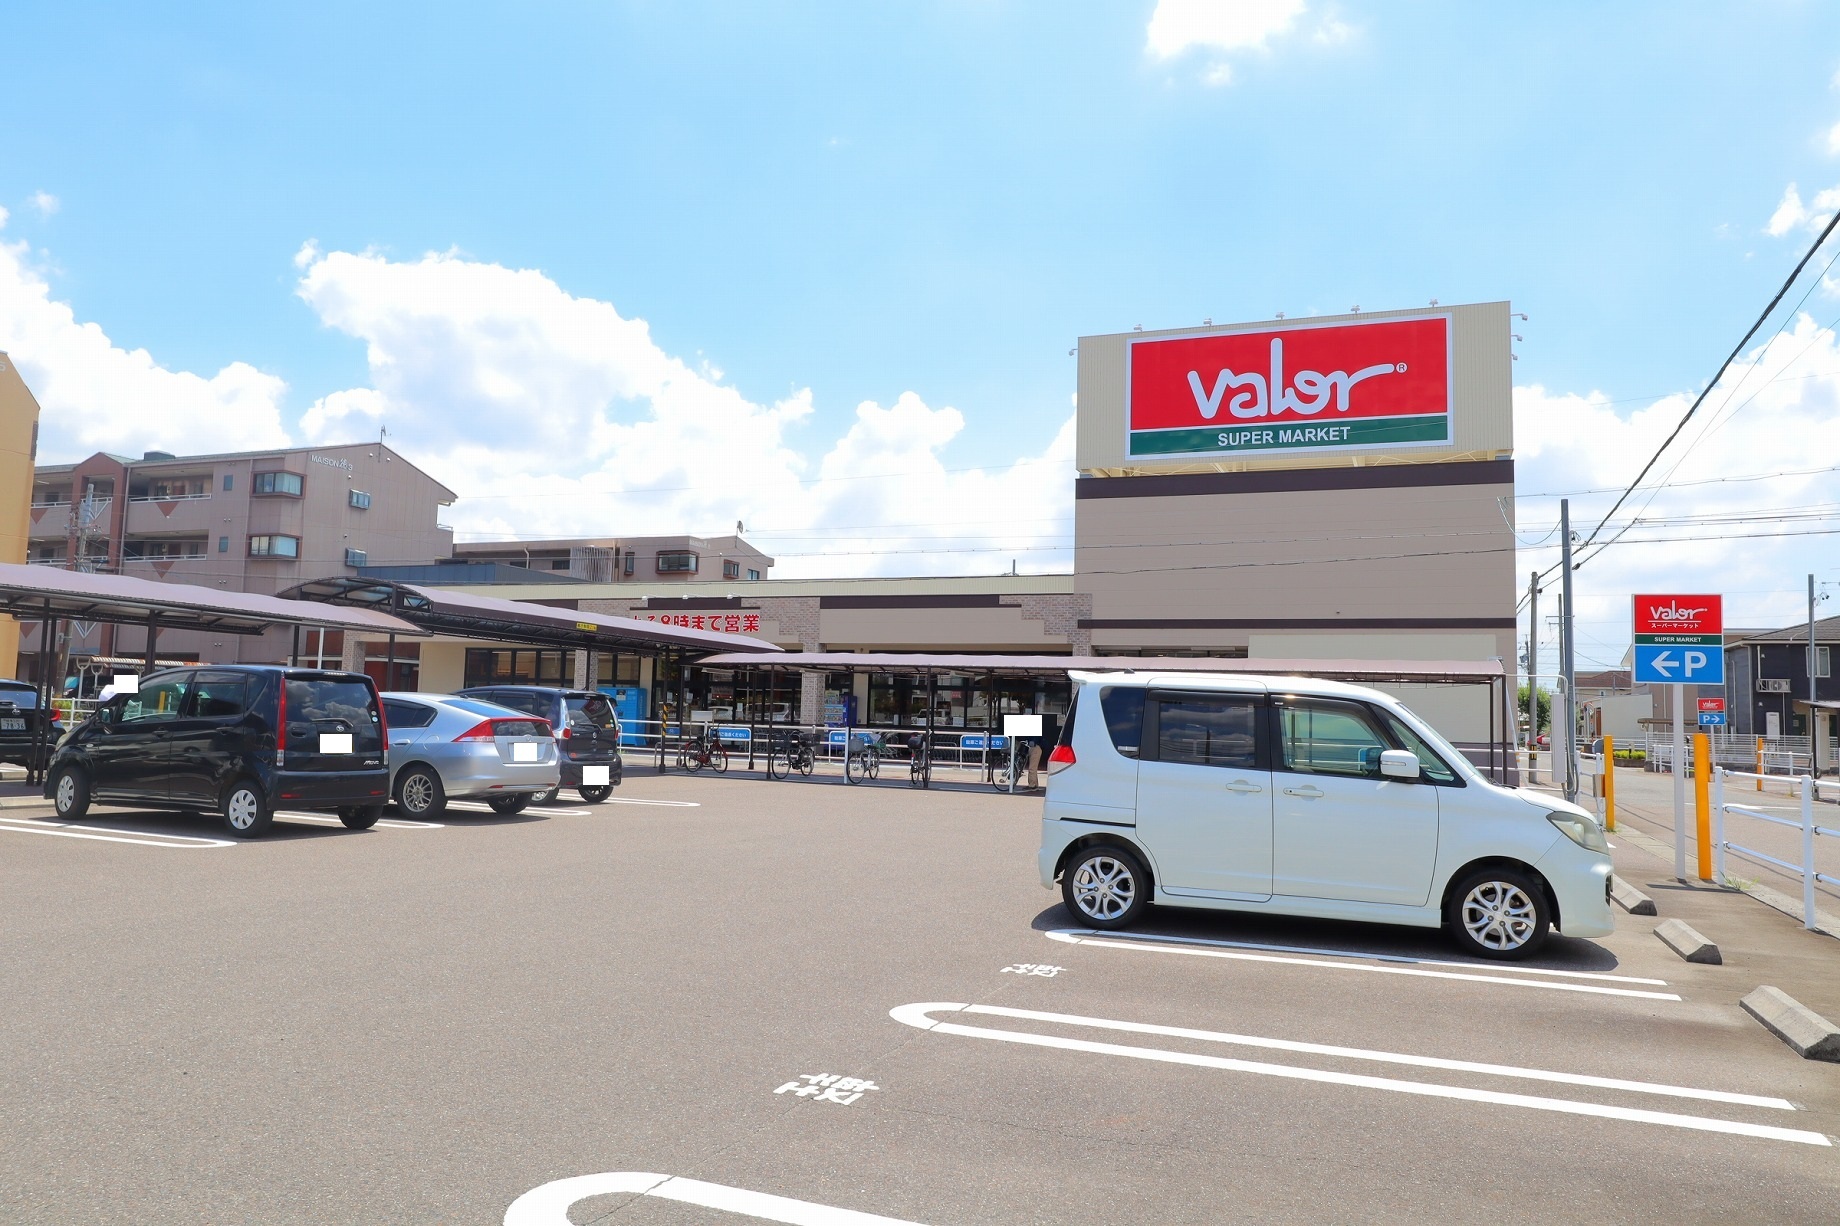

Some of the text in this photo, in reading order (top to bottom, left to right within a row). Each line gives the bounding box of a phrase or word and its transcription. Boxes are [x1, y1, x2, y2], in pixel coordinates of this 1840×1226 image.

[1187, 337, 1395, 419] valor
[1217, 426, 1351, 446] SUPER MARKET
[311, 454, 339, 467] MAISON
[1650, 599, 1705, 620] valor
[1684, 651, 1707, 677] P
[1703, 715, 1711, 723] P
